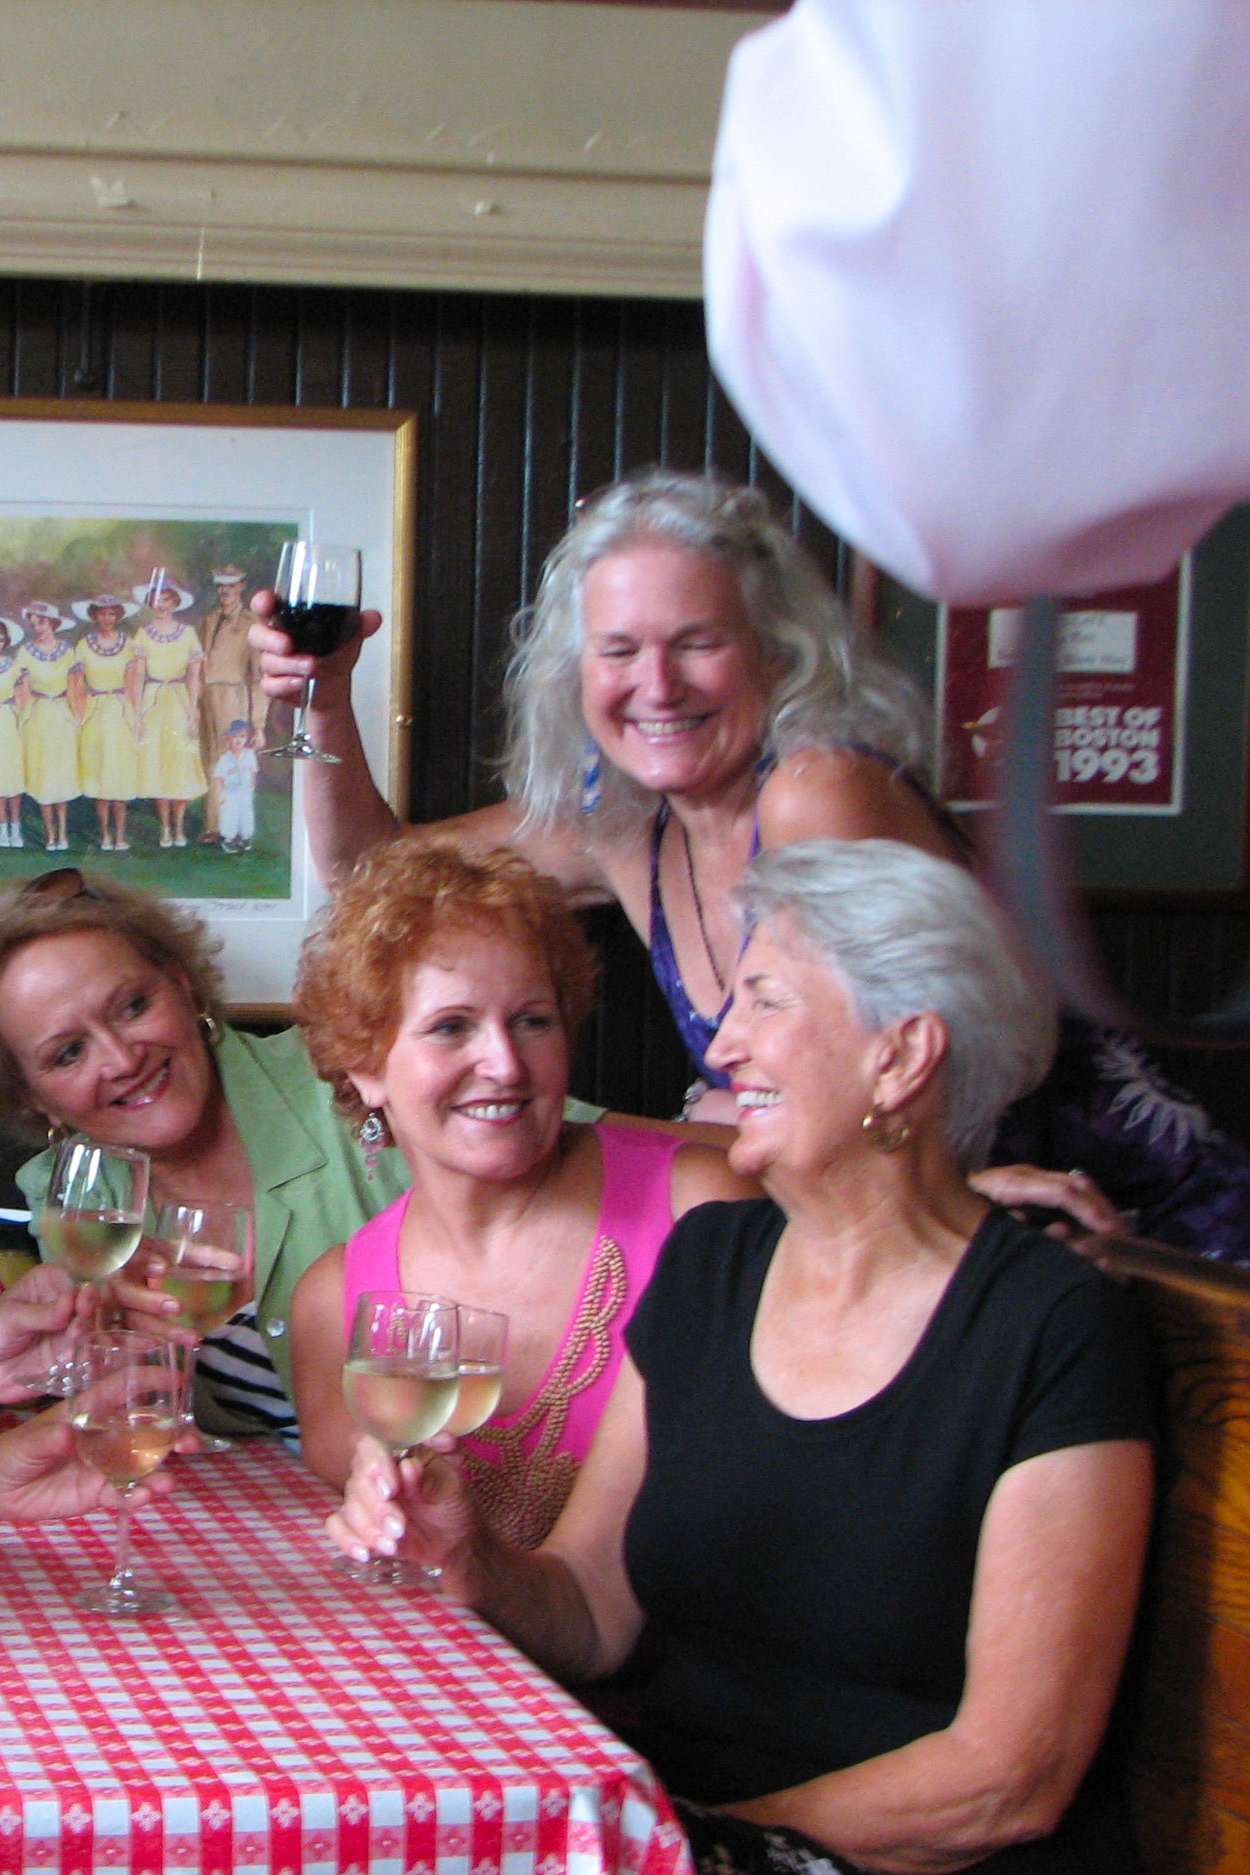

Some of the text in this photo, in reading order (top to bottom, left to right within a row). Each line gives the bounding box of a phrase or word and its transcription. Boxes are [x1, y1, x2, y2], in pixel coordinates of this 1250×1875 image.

[1056, 706, 1163, 728] BEST OF
[1054, 727, 1160, 749] BOSTON
[1054, 748, 1158, 784] 1993
